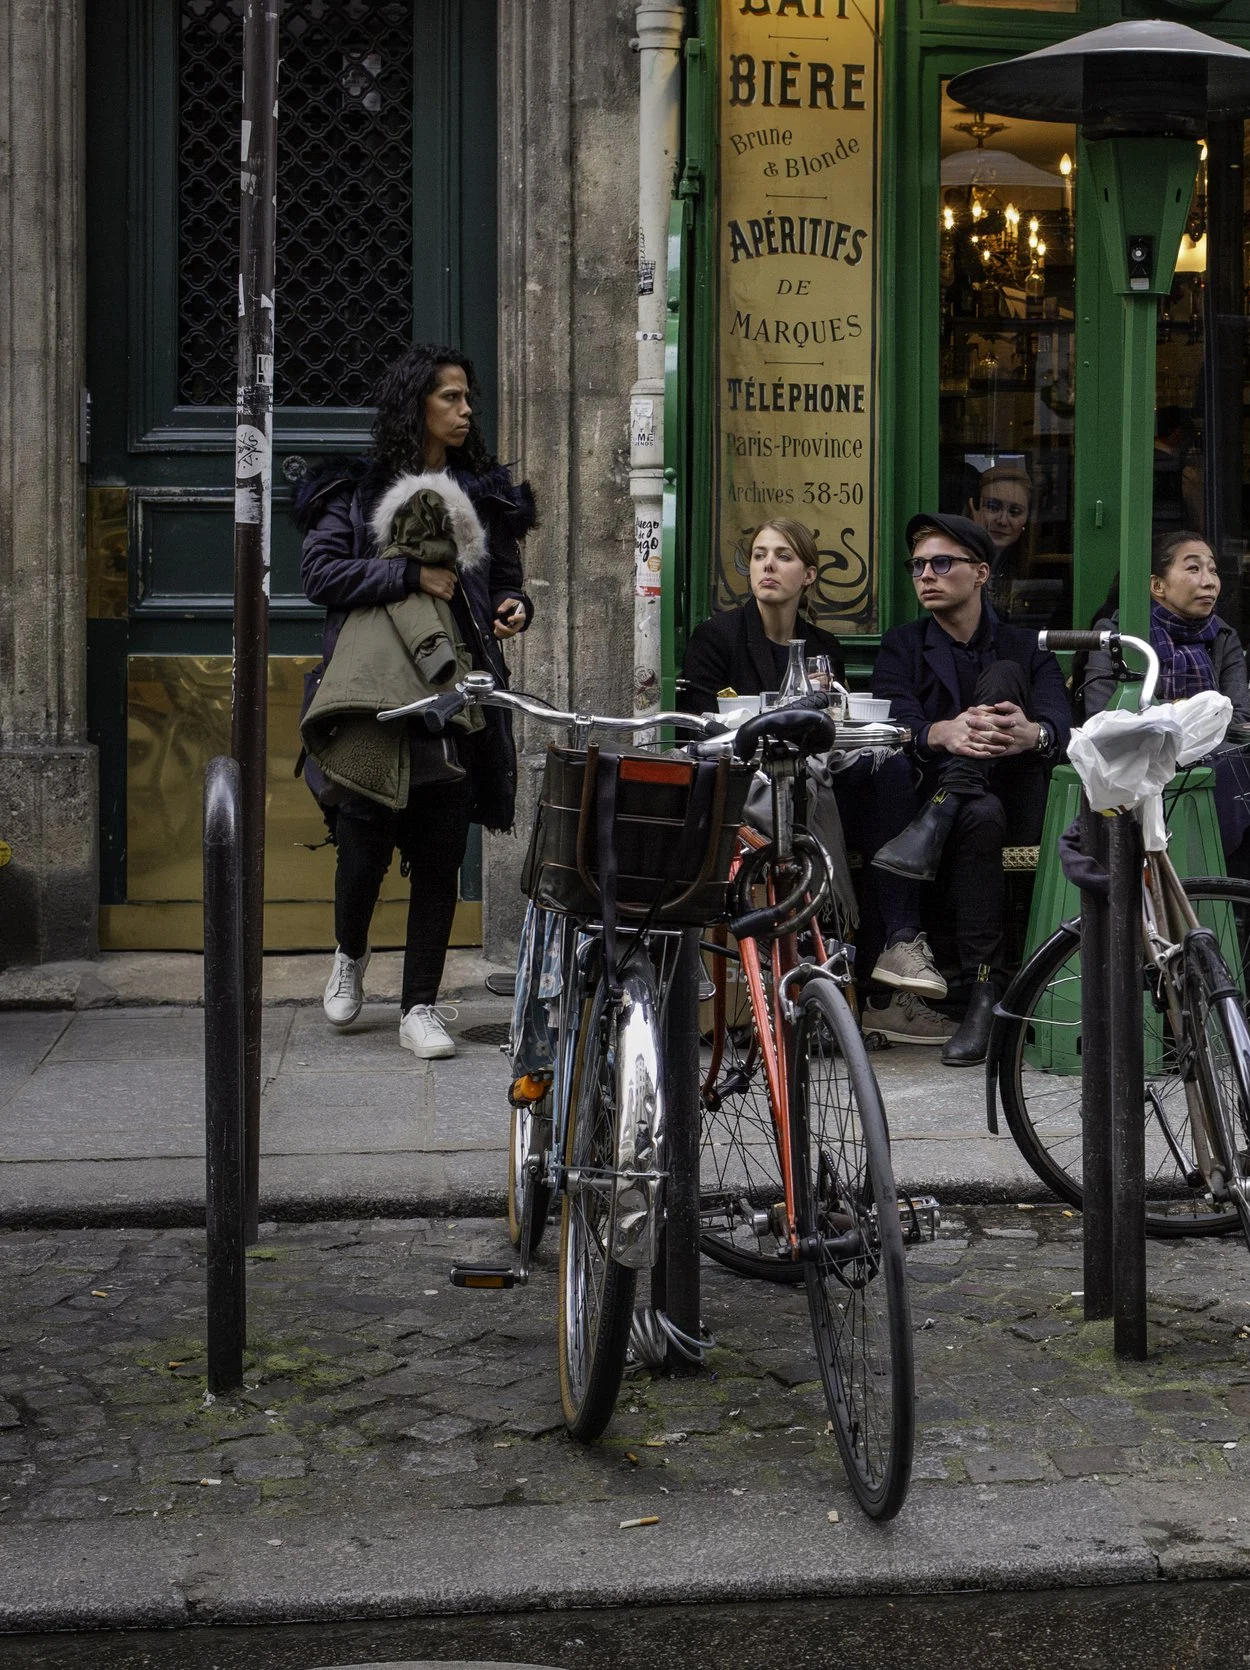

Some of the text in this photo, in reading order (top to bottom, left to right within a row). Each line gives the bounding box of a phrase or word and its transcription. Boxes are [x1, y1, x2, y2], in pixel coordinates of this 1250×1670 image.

[729, 51, 866, 110] BIÈRE
[730, 128, 793, 155] Brune
[763, 137, 860, 178] & Blonde
[727, 210, 868, 267] APÉRITIFS
[776, 279, 811, 296] DE
[728, 310, 863, 348] MARQUES
[727, 376, 865, 413] TÉLÉPHONE
[727, 432, 863, 460] Paris-Province
[728, 481, 864, 505] Archives 38-50
